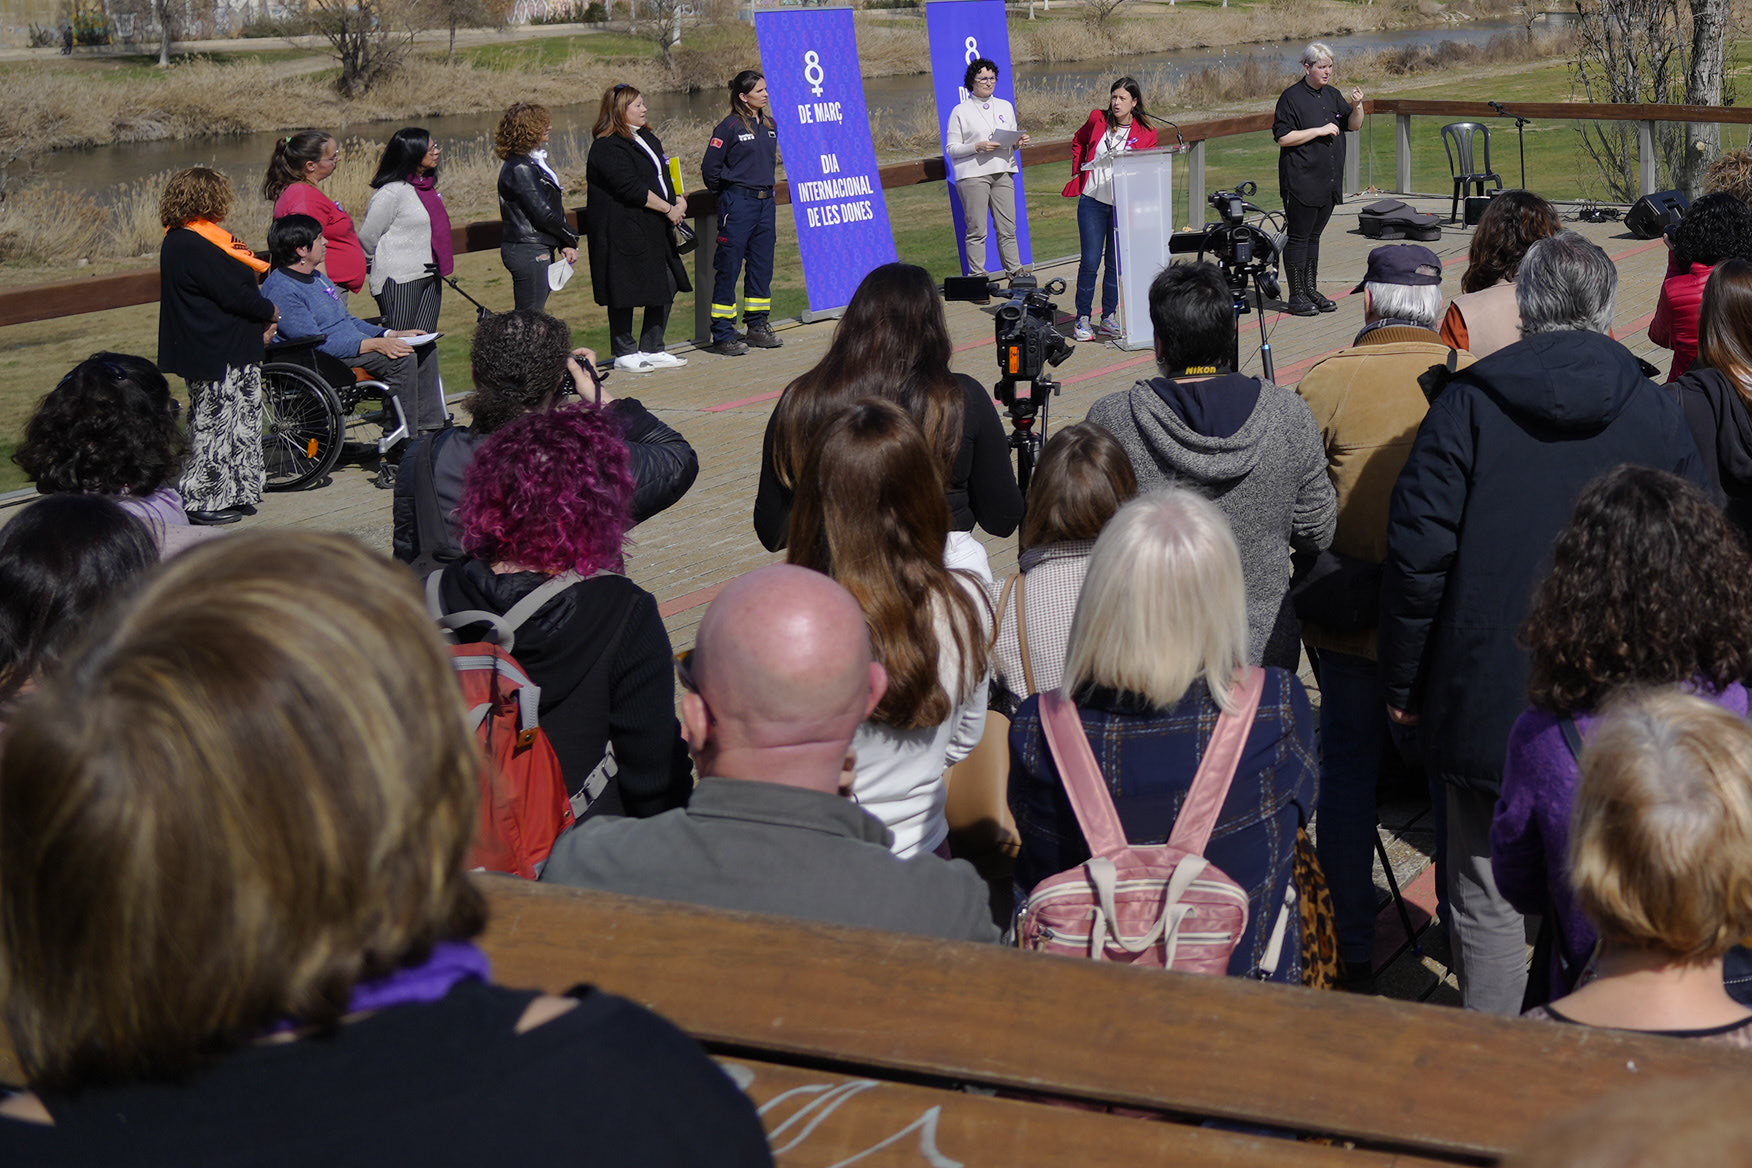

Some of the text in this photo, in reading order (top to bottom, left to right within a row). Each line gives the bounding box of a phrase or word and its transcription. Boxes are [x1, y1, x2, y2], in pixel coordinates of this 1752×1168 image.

[804, 50, 824, 86] 8
[798, 101, 843, 125] DE MARÇ
[820, 153, 840, 174] DIA
[798, 175, 874, 203] INTERNACIONAL
[806, 200, 874, 228] DE LES DONES
[1185, 366, 1217, 375] Nikon
